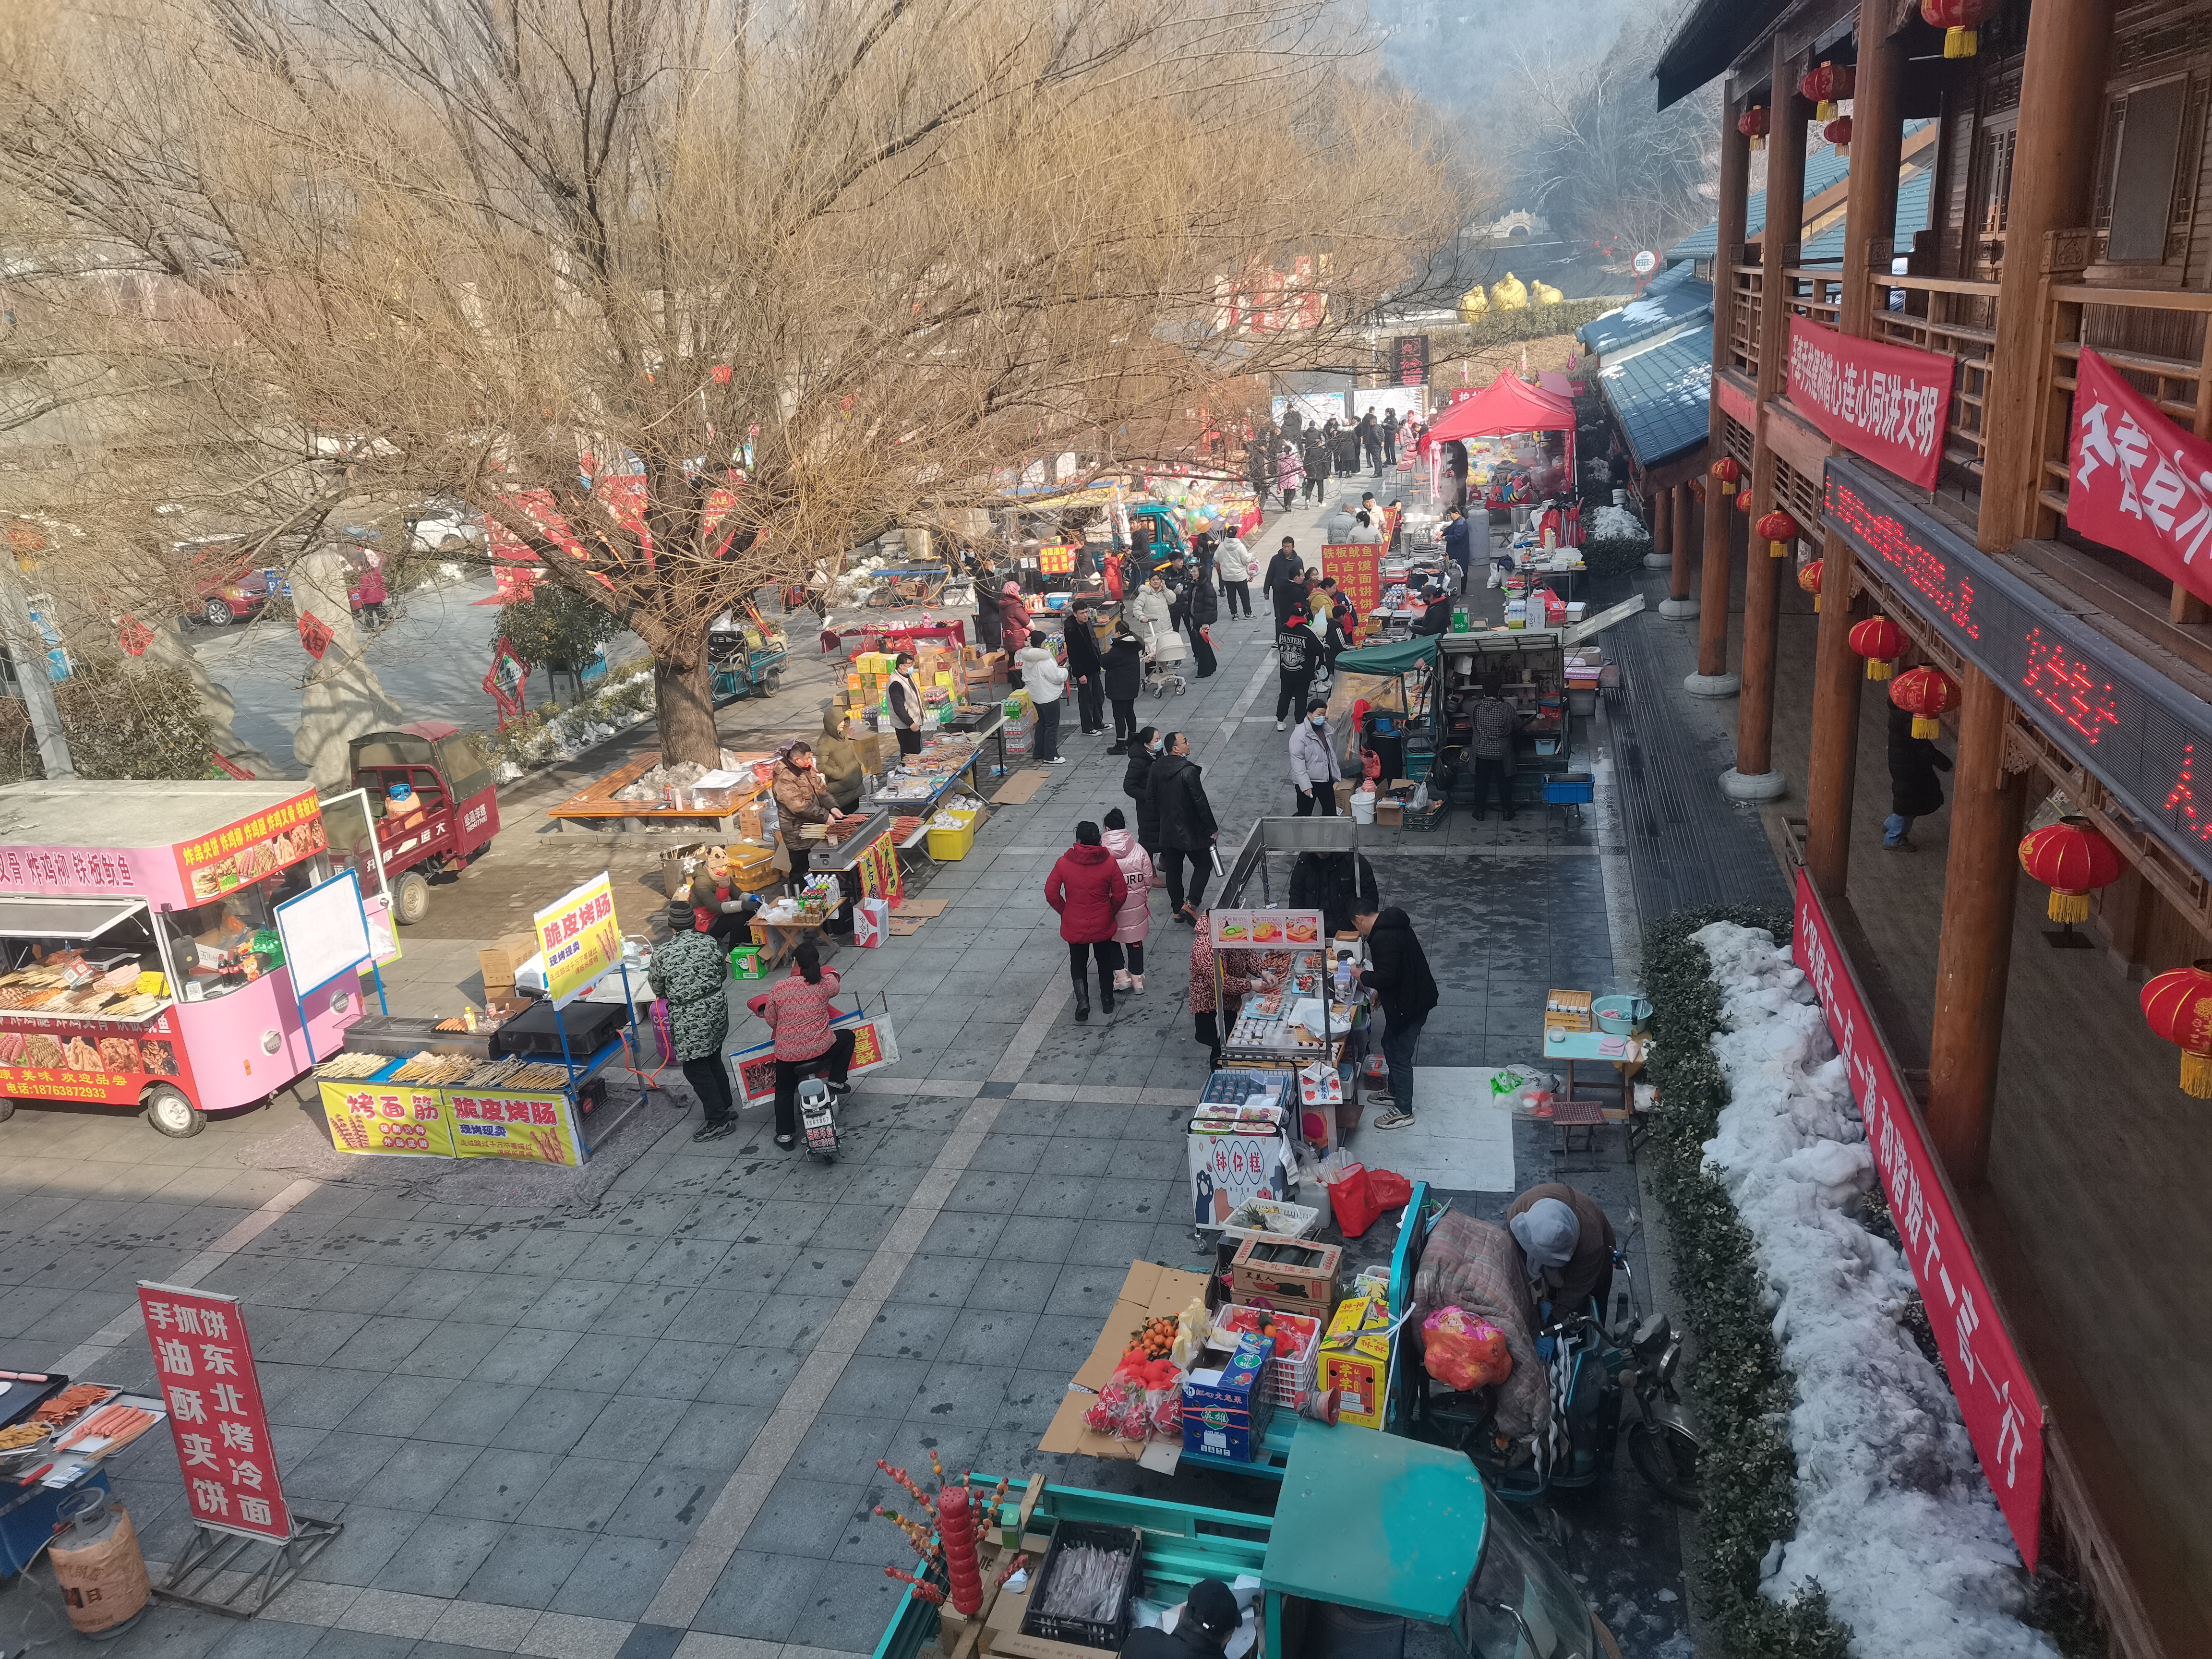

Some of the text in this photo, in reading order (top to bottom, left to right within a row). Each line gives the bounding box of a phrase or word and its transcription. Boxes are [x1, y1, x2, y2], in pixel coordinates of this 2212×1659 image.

[1040, 547, 1067, 555] 鸡蛋灌饼
[1323, 546, 1373, 559] 铁板鱿鱼
[1043, 563, 1068, 572] 手抓饼
[1326, 560, 1372, 573] 白吉馍
[1342, 586, 1373, 597] 抓饼
[1279, 634, 1306, 649] PANTERA
[182, 837, 220, 866] 炸串夹饼
[219, 828, 243, 852] 炸鸡柳
[243, 817, 267, 842] 炸鸡腿
[266, 805, 296, 831] 炸鸡叉骨
[25, 851, 71, 887] 炸鸡柳
[71, 851, 135, 888] 铁板鱿鱼
[543, 891, 611, 951] 脆皮烤肠
[548, 940, 580, 967] 现烤现卖
[21, 1070, 54, 1082] 美味
[61, 1071, 128, 1086] 欢迎品尝
[6, 1082, 107, 1099] 电话:18763872933
[347, 1092, 439, 1121] 烤面筋
[451, 1096, 558, 1125] 脆皮烤肠
[806, 1117, 829, 1126] 1361857
[1215, 1150, 1261, 1173] 钵仔糕
[1803, 903, 2025, 1488] 文明源于一点一滴 和谐始于一言一行
[1245, 1272, 1274, 1282] 黑美人
[146, 1300, 228, 1341] 手抓饼
[1196, 1388, 1243, 1404] 红心火龙果
[1204, 1411, 1226, 1423] 英雄
[156, 1336, 230, 1517] 油酥夹饼
[199, 1344, 272, 1526] 东北烤冷面
